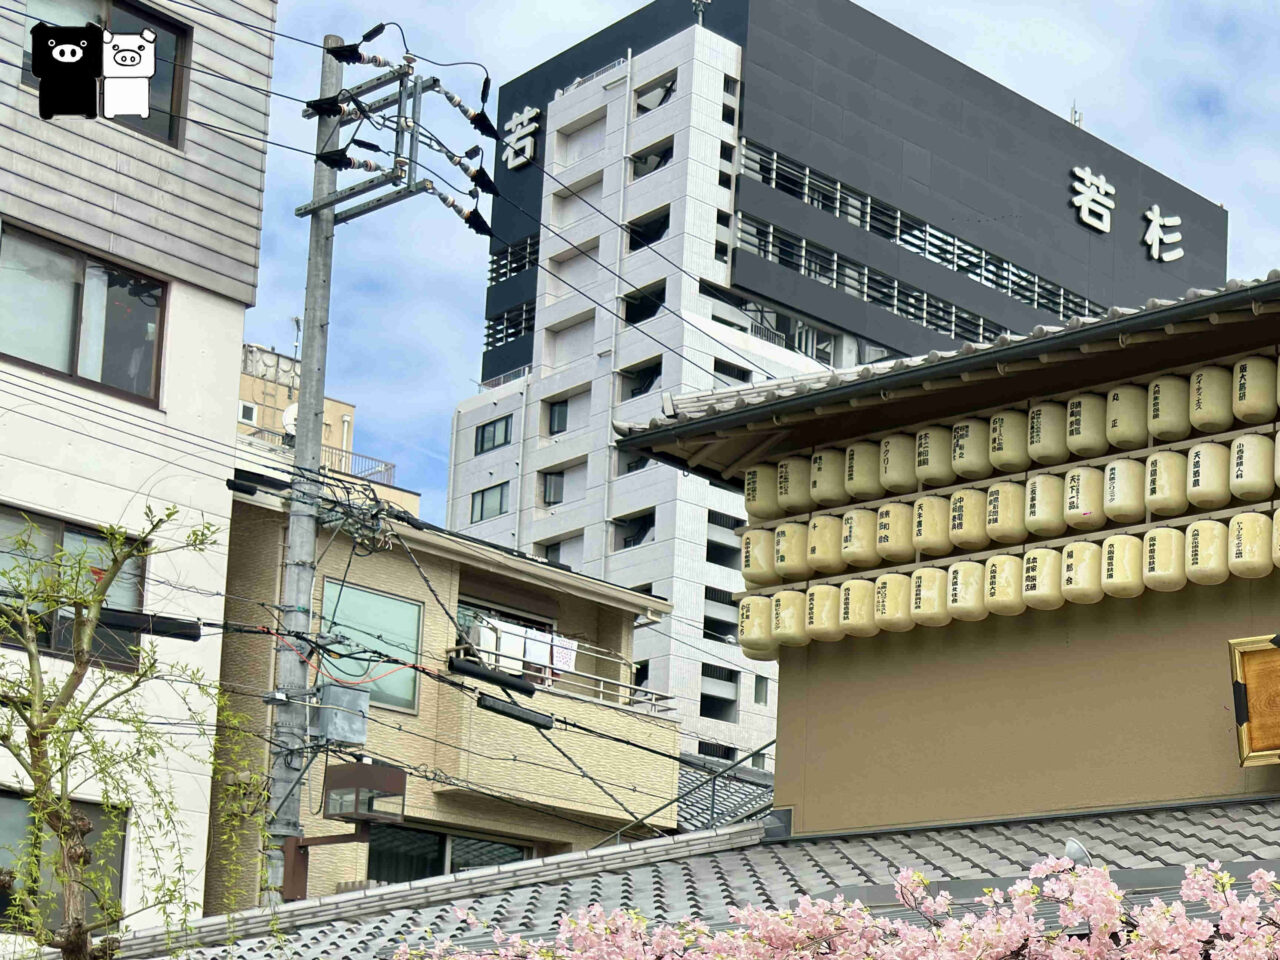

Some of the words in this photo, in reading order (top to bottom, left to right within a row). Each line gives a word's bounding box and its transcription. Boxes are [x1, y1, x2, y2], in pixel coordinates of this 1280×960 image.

[502, 107, 541, 170] 若
[1070, 165, 1184, 264] 若杉
[1068, 474, 1077, 511] 天下一品
